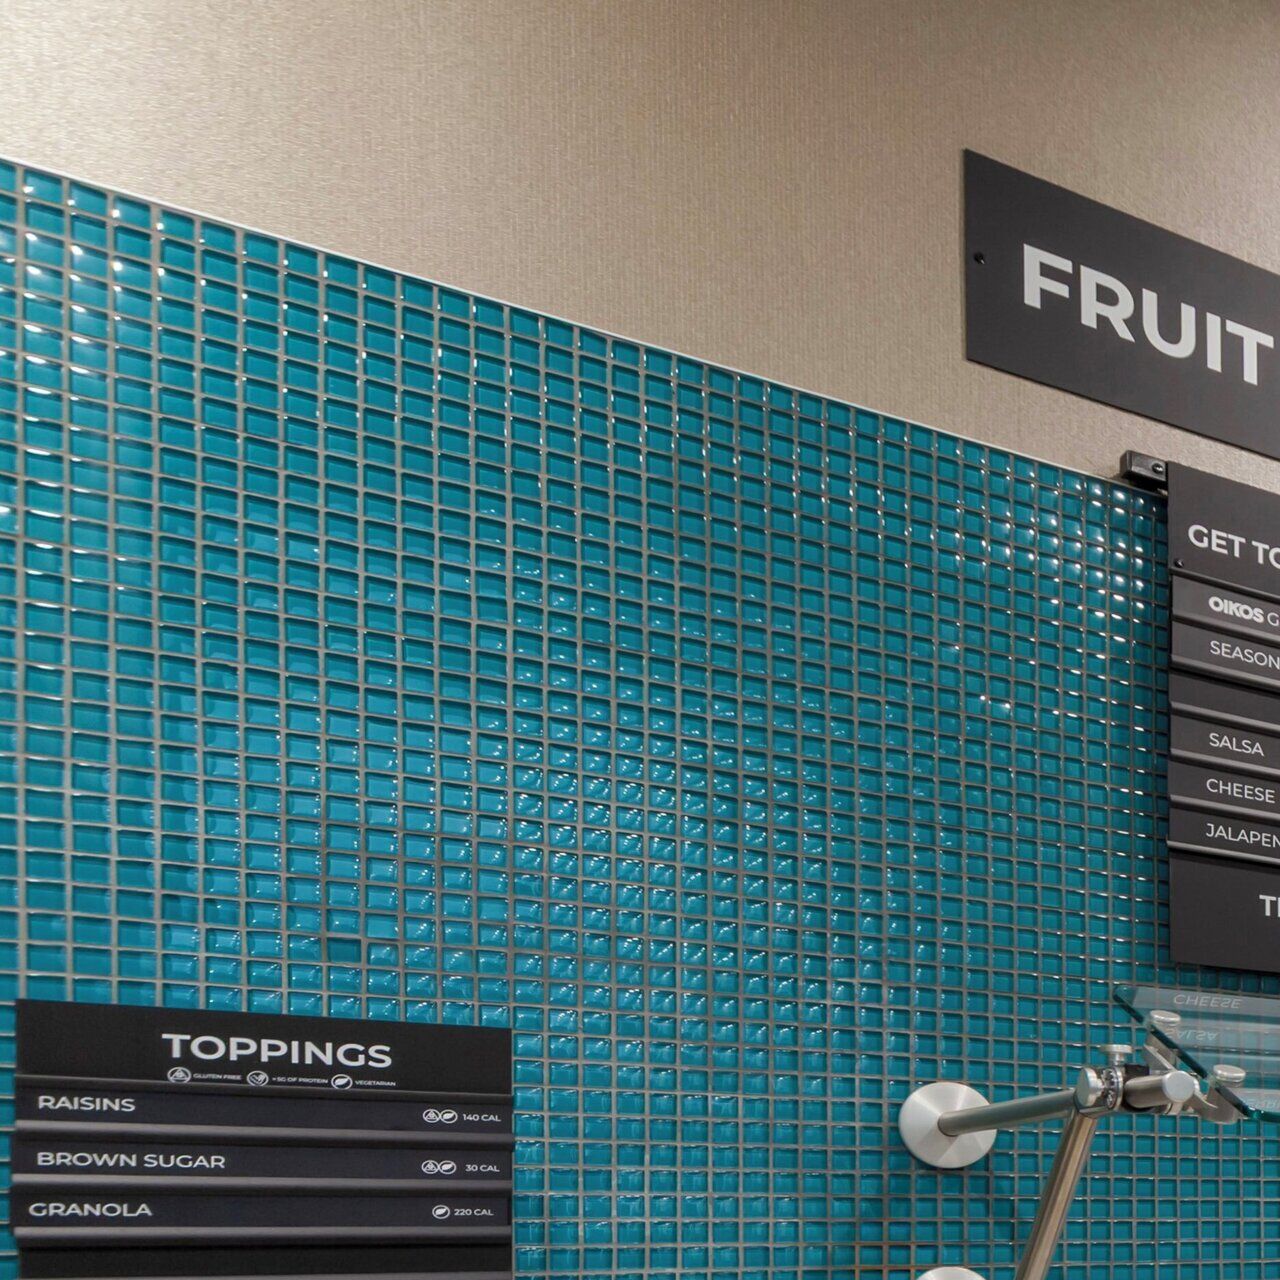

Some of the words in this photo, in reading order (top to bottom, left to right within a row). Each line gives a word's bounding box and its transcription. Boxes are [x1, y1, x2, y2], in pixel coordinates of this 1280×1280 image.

[1022, 243, 1274, 386] FRUIT
[1188, 524, 1245, 558] GET
[1208, 596, 1264, 623] OIKOS
[1209, 733, 1265, 757] SALSA
[1206, 778, 1276, 804] CHEESE
[162, 1033, 393, 1069] TOPPINGS
[38, 1095, 136, 1112] RAISINS
[481, 1114, 501, 1122] CAL
[36, 1151, 138, 1168] BROWN
[144, 1153, 226, 1169] SUGAR
[465, 1164, 478, 1172] 30
[28, 1202, 153, 1217] GRANOLA
[454, 1208, 472, 1216] 220
[473, 1208, 494, 1216] CAL
